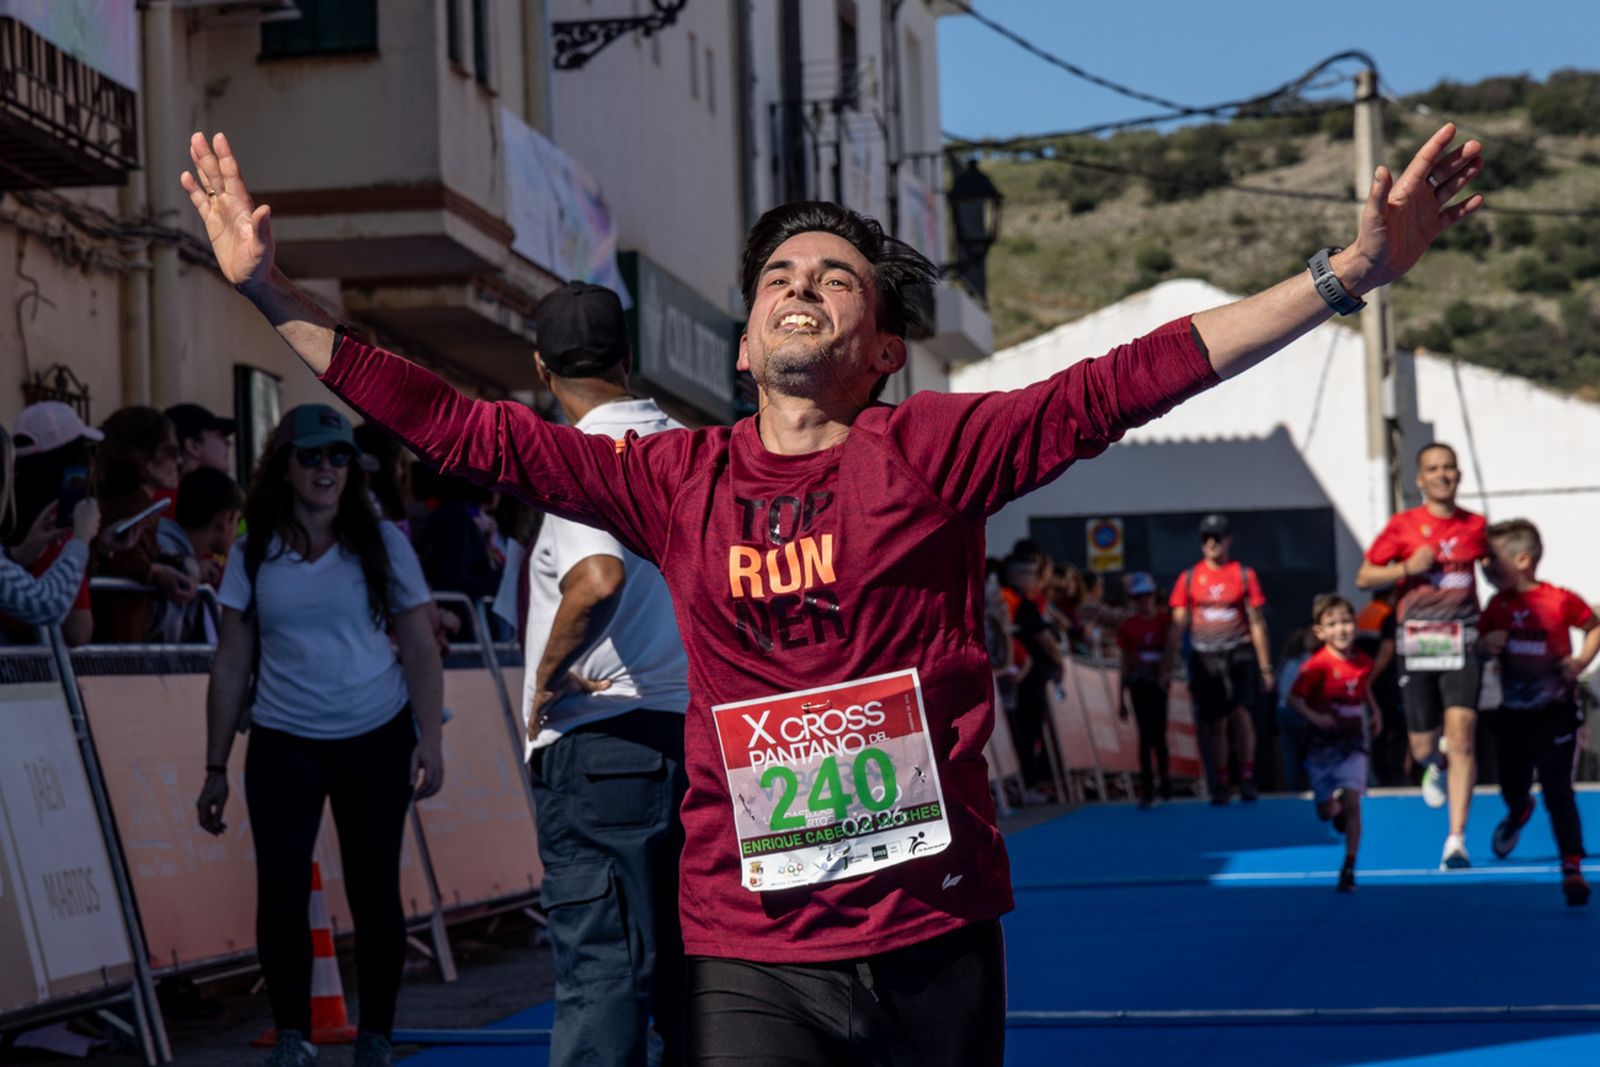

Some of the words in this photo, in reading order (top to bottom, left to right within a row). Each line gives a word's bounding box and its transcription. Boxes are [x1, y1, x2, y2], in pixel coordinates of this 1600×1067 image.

[735, 490, 834, 545] TOP
[729, 533, 836, 599] RUN
[733, 589, 847, 655] NER
[741, 710, 777, 749] X
[780, 701, 886, 743] CROSS
[748, 732, 866, 773] PANTANO
[869, 731, 890, 744] DEL
[760, 748, 897, 831] 240
[742, 833, 804, 855] ENRIQUE
[41, 866, 101, 919] MARTOS
